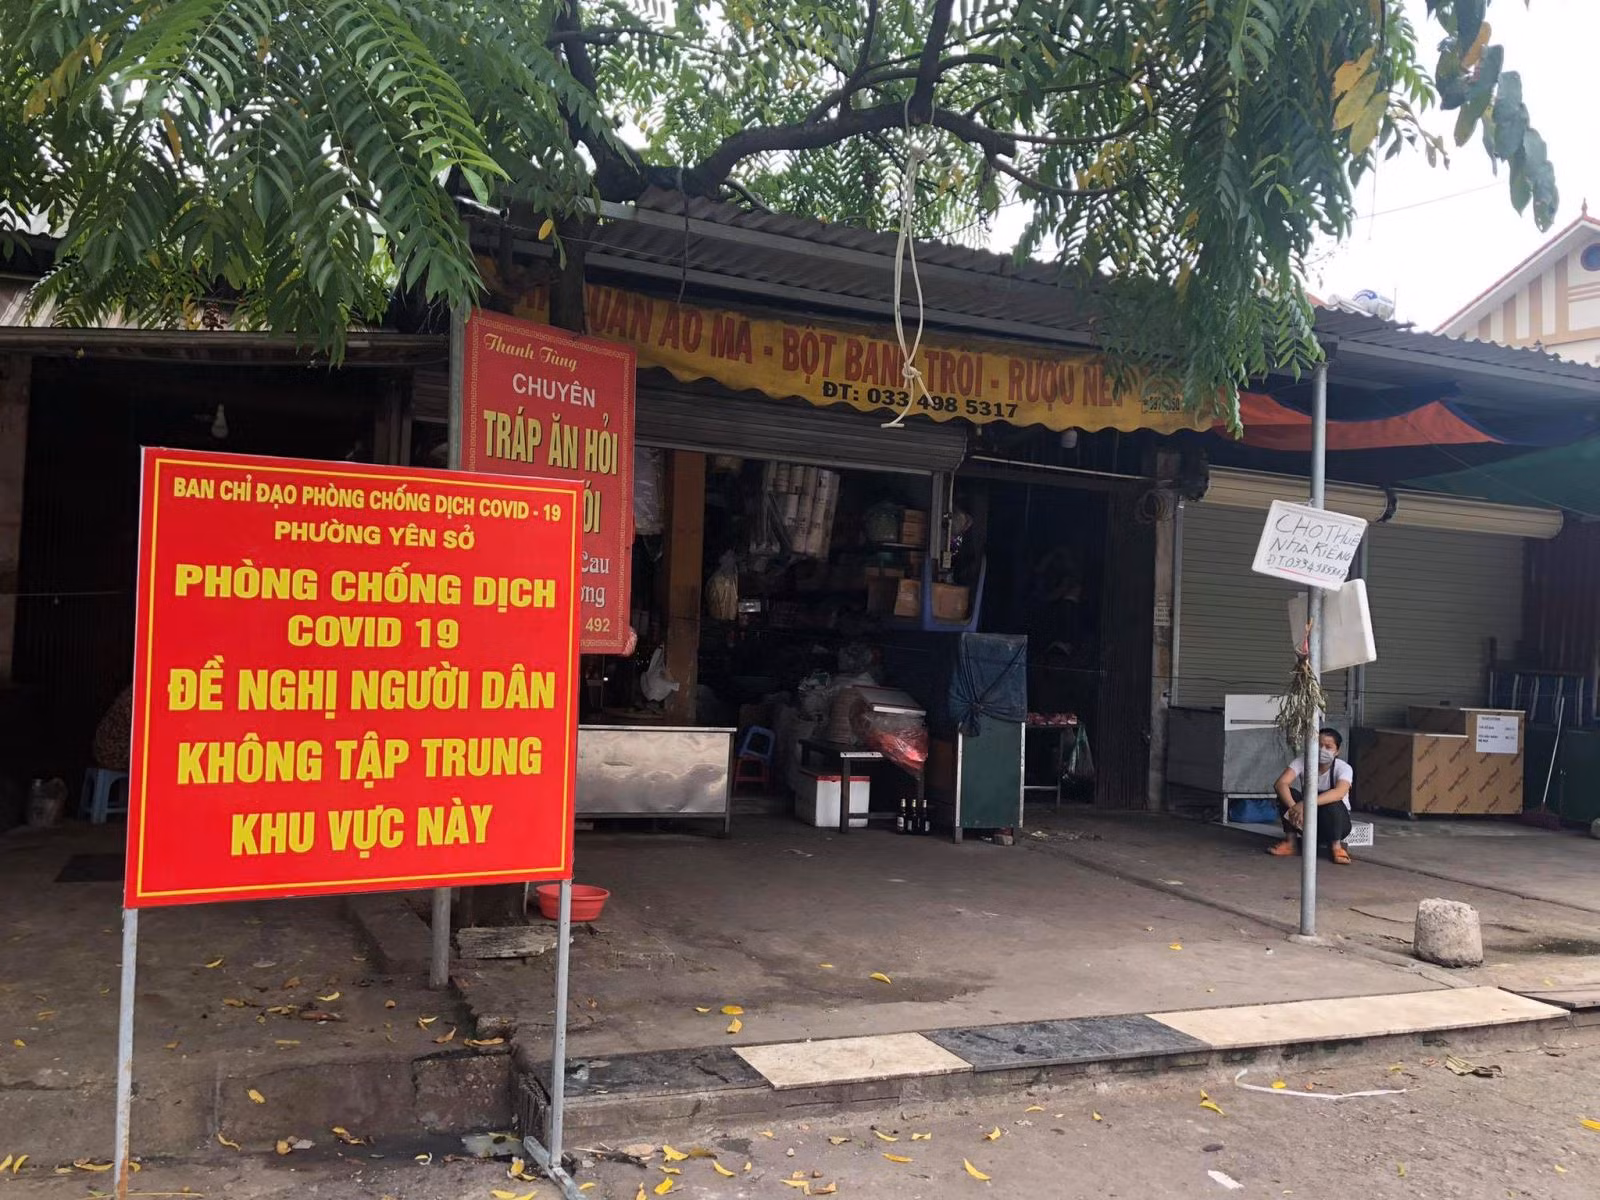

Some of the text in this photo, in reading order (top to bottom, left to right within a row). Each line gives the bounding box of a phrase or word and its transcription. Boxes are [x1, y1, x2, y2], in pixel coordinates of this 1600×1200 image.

[483, 332, 579, 373] Thanh Tùng
[512, 372, 597, 409] CHUYÊN
[822, 380, 1019, 419] ĐT: 033 498 5317
[483, 406, 620, 476] TRÁP ĂN HỎI
[173, 476, 215, 500] BAN
[219, 474, 253, 502] CHỈ
[256, 483, 298, 510] ĐẠO
[302, 482, 365, 509] PHÒNG
[369, 484, 431, 513] CHỐNG
[435, 494, 475, 520] DỊCH
[479, 498, 530, 520] COVID
[542, 503, 563, 522] 19
[274, 518, 476, 550] PHƯỜNG YÊN SỞ
[174, 558, 558, 613] PHÒNG CHỐNG DỊCH
[287, 614, 461, 650] COVID 19
[585, 617, 611, 634] 492
[167, 654, 556, 720] ĐỀ NGHỊ NGƯỜI DÂN
[176, 730, 543, 789] KHÔNG TẬP TRUNG
[230, 797, 494, 859] KHU VỰC NÀY
